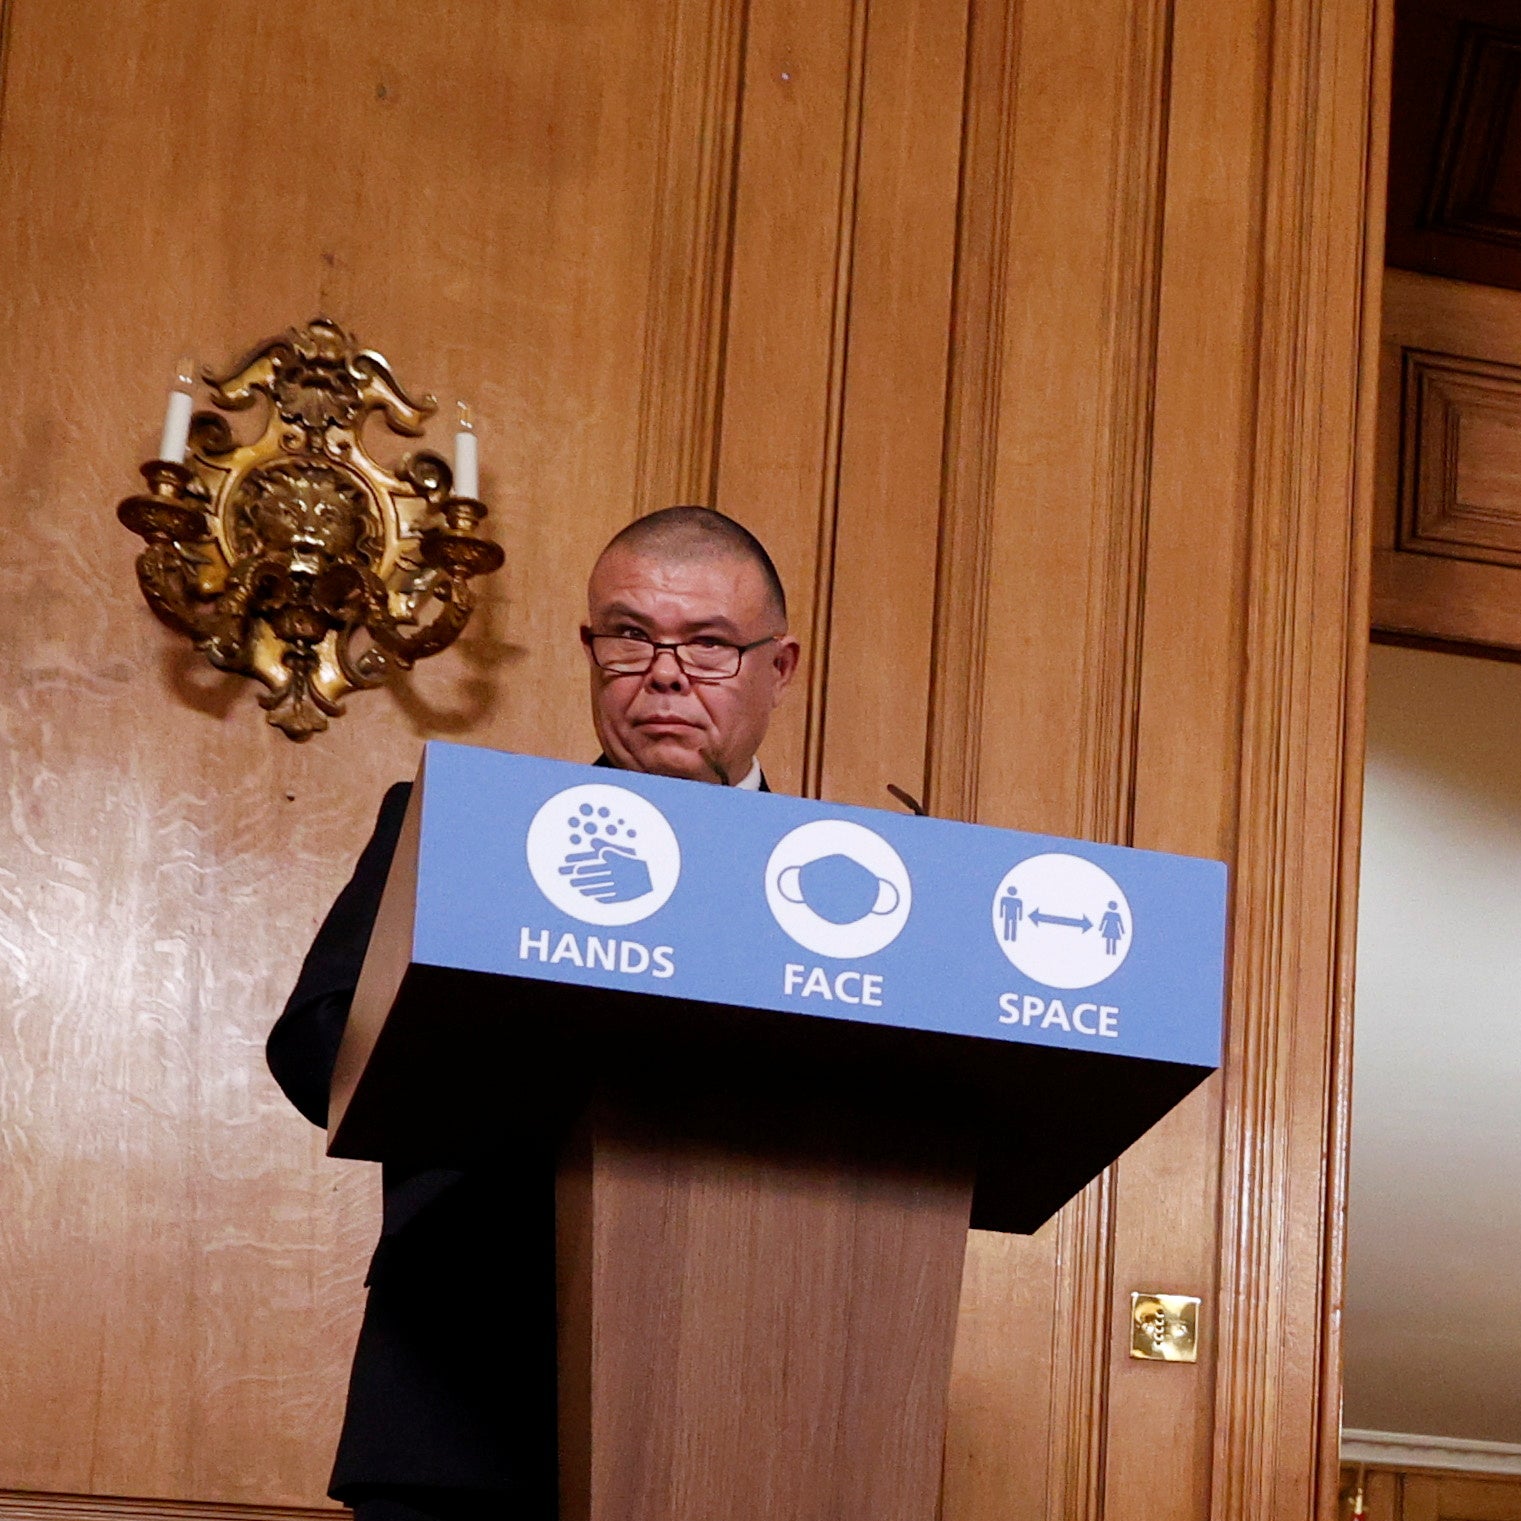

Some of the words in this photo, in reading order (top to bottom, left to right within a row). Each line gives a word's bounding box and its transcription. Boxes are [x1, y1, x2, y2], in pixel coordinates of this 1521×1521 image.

[518, 926, 676, 979] HANDS
[783, 963, 884, 1007] FACE
[998, 992, 1120, 1038] SPACE
